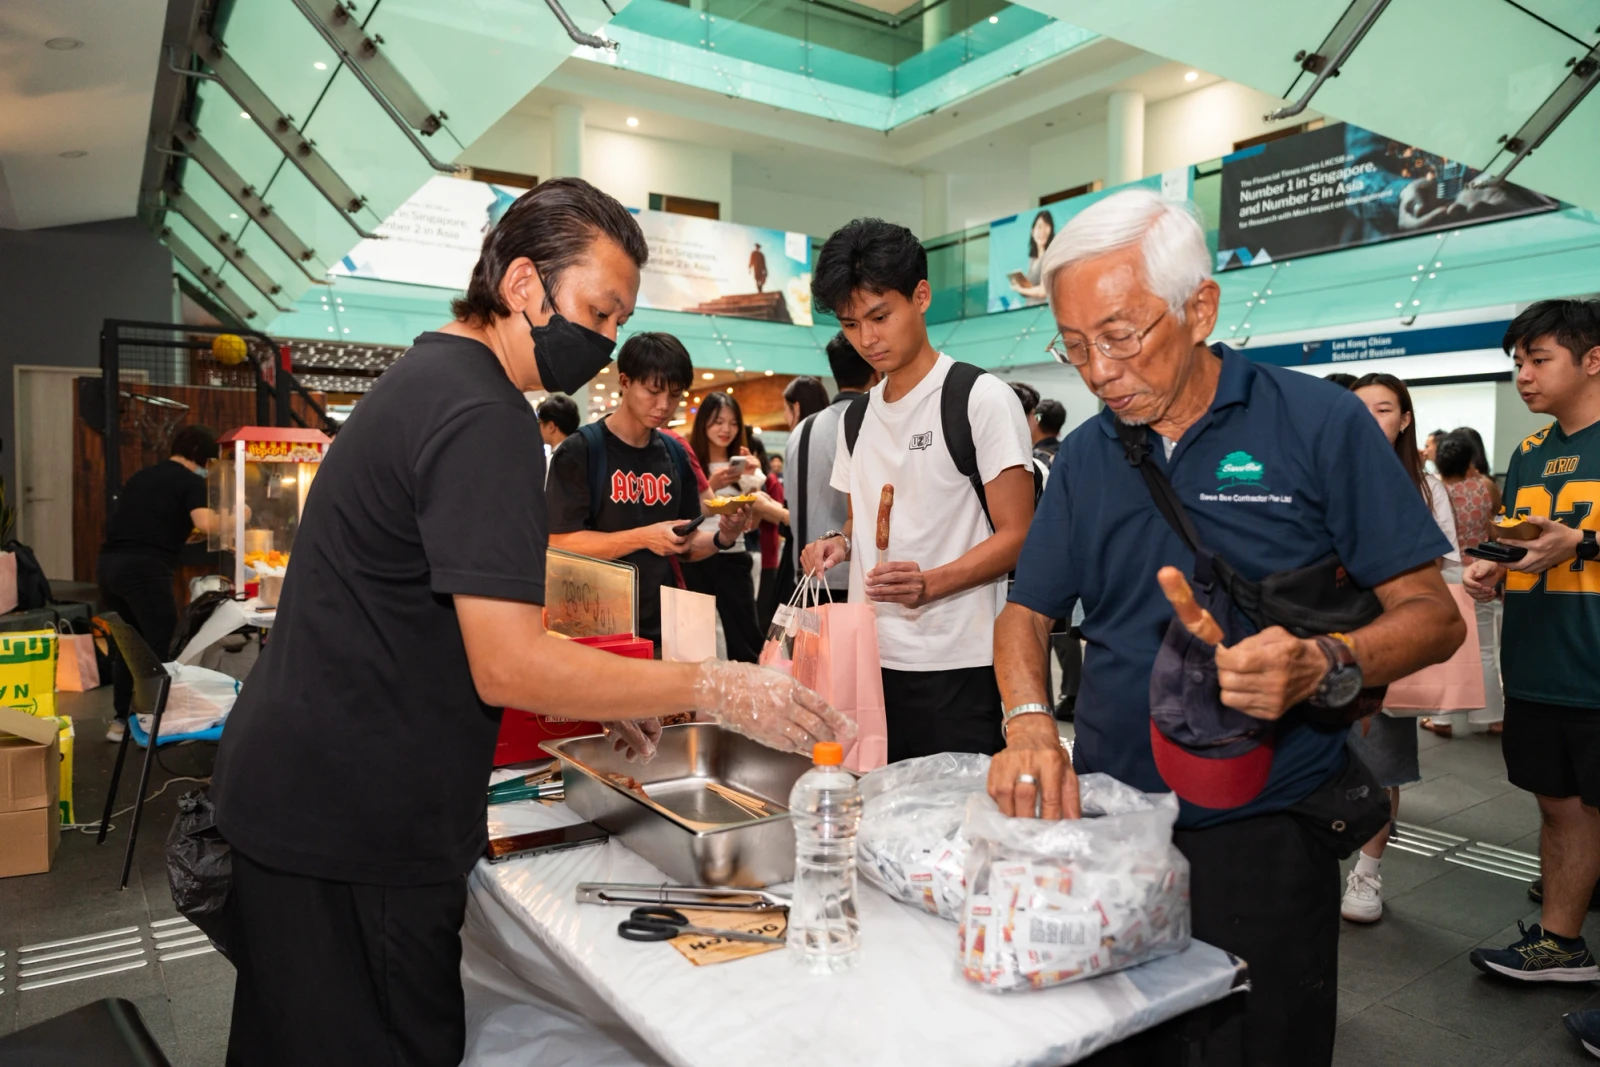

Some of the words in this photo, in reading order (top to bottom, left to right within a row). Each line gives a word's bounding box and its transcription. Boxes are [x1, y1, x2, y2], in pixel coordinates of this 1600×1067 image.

[1240, 183, 1286, 203] Number
[1287, 179, 1294, 192] 1
[1296, 177, 1307, 190] in
[1309, 161, 1377, 187] Singapore,
[1241, 180, 1252, 188] The
[1252, 172, 1280, 185] Financial
[1281, 169, 1300, 178] Times
[1239, 202, 1260, 218] and
[1262, 192, 1310, 212] Number
[1311, 187, 1320, 202] 2
[1321, 186, 1334, 199] in
[1335, 179, 1364, 197] Asia
[1239, 221, 1248, 229] for
[1248, 215, 1277, 227] Research
[1277, 211, 1292, 220] with
[1293, 207, 1310, 217] Most
[1310, 200, 1334, 213] Impact
[1345, 189, 1393, 206] Management
[1332, 341, 1346, 350] Lee
[1347, 339, 1367, 350] Kong
[1368, 336, 1392, 347] Chian
[1332, 350, 1358, 361] School
[1360, 349, 1368, 359] of
[1369, 347, 1406, 359] Business
[248, 443, 287, 459] Popcorn
[1199, 493, 1217, 501] Swee
[1219, 493, 1232, 502] Bee
[1233, 494, 1268, 503] Contractor
